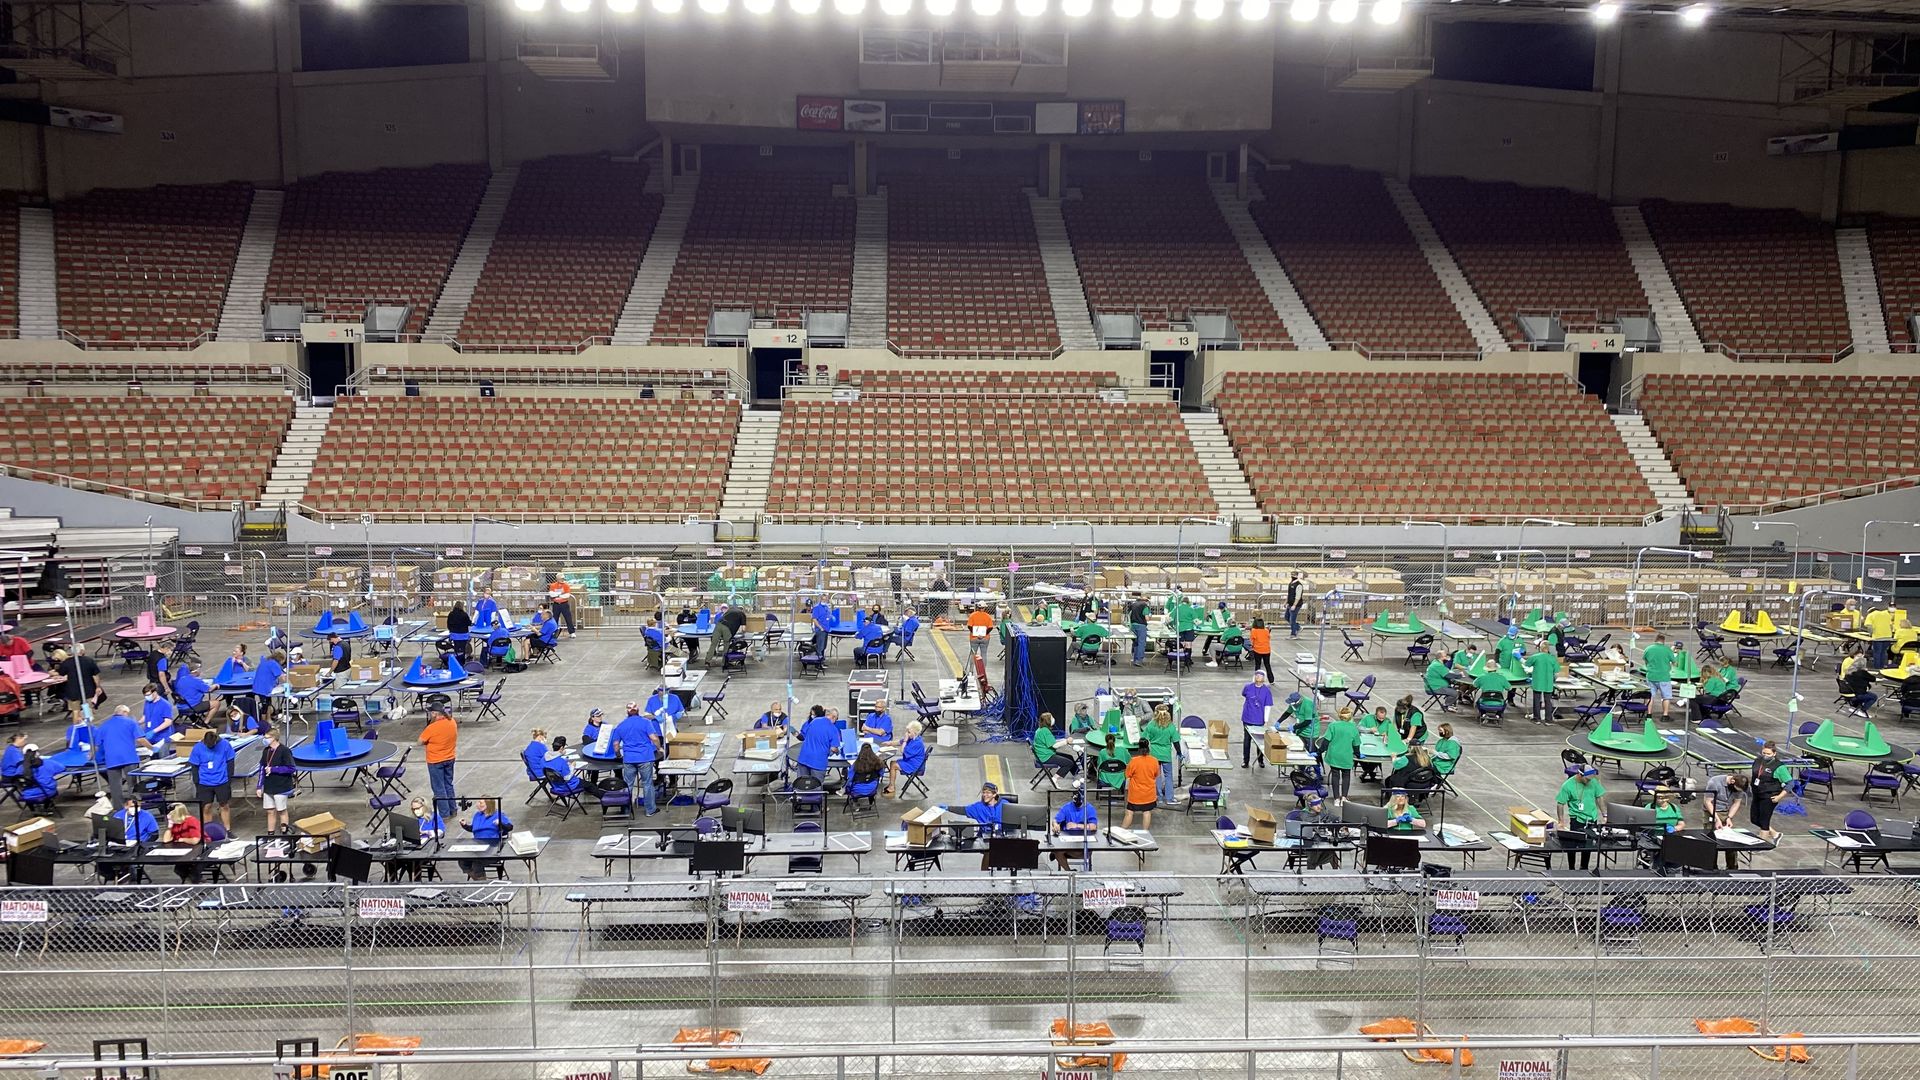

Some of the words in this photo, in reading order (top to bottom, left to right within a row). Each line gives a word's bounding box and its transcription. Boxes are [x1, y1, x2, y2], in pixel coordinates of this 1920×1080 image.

[800, 103, 838, 120] Coca-Cola
[344, 329, 354, 337] 11
[787, 335, 797, 343] 12
[1179, 337, 1189, 346] 13
[1604, 339, 1615, 347] 14
[729, 892, 770, 901] NATIONAL
[1084, 888, 1124, 898] NATIONAL
[1438, 890, 1477, 900] NATIONAL
[3, 902, 45, 911] NATIONAL
[361, 899, 404, 908] NATIONAL
[1500, 1061, 1551, 1072] NATIONAL
[566, 1072, 612, 1080] NATIONA
